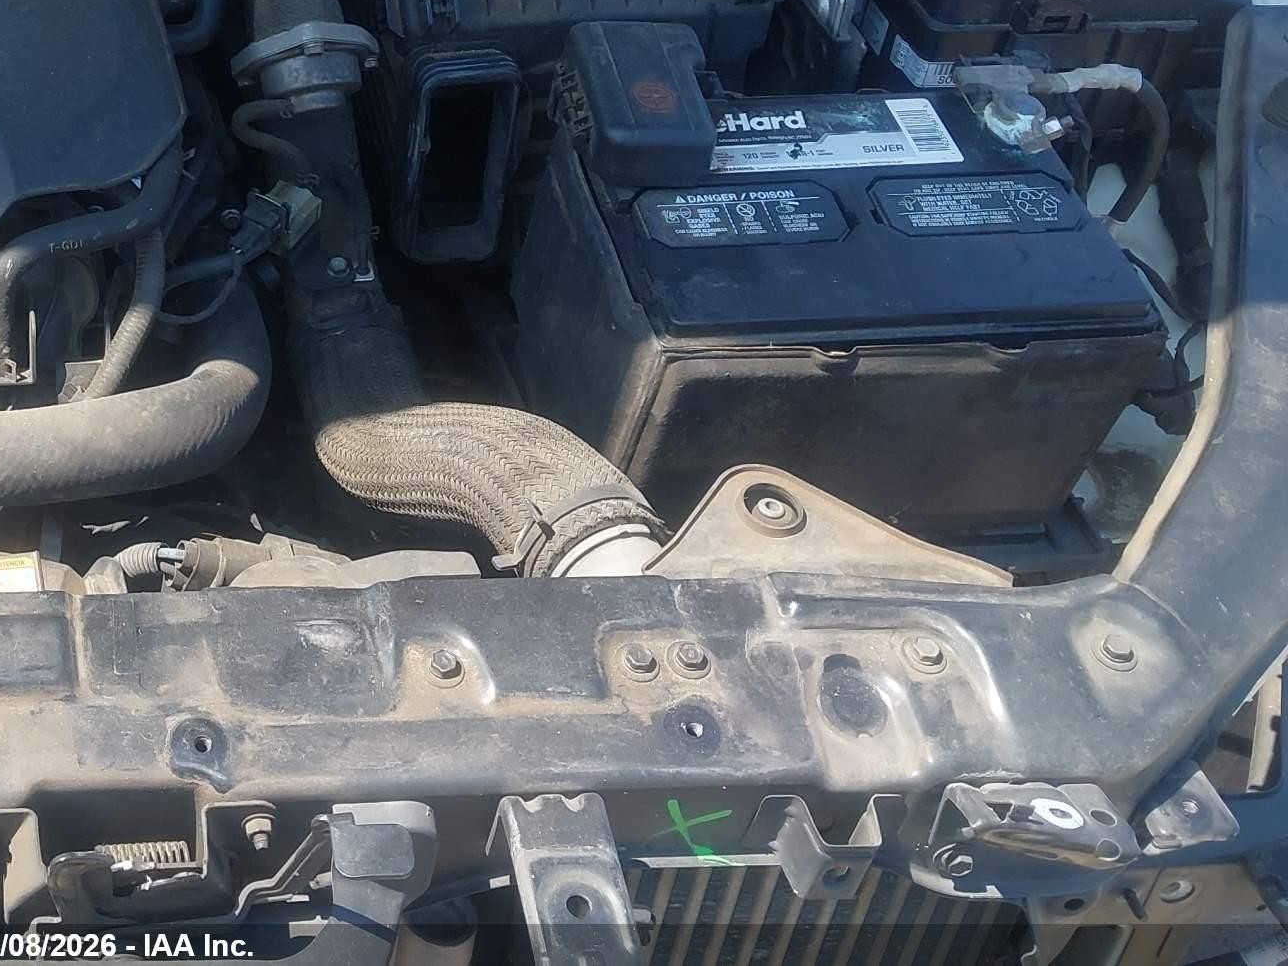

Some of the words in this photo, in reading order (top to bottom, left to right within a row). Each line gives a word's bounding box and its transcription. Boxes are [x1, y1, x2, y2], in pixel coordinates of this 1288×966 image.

[862, 143, 905, 154] SILVER
[686, 193, 738, 203] DANGER
[749, 189, 795, 200] POISON
